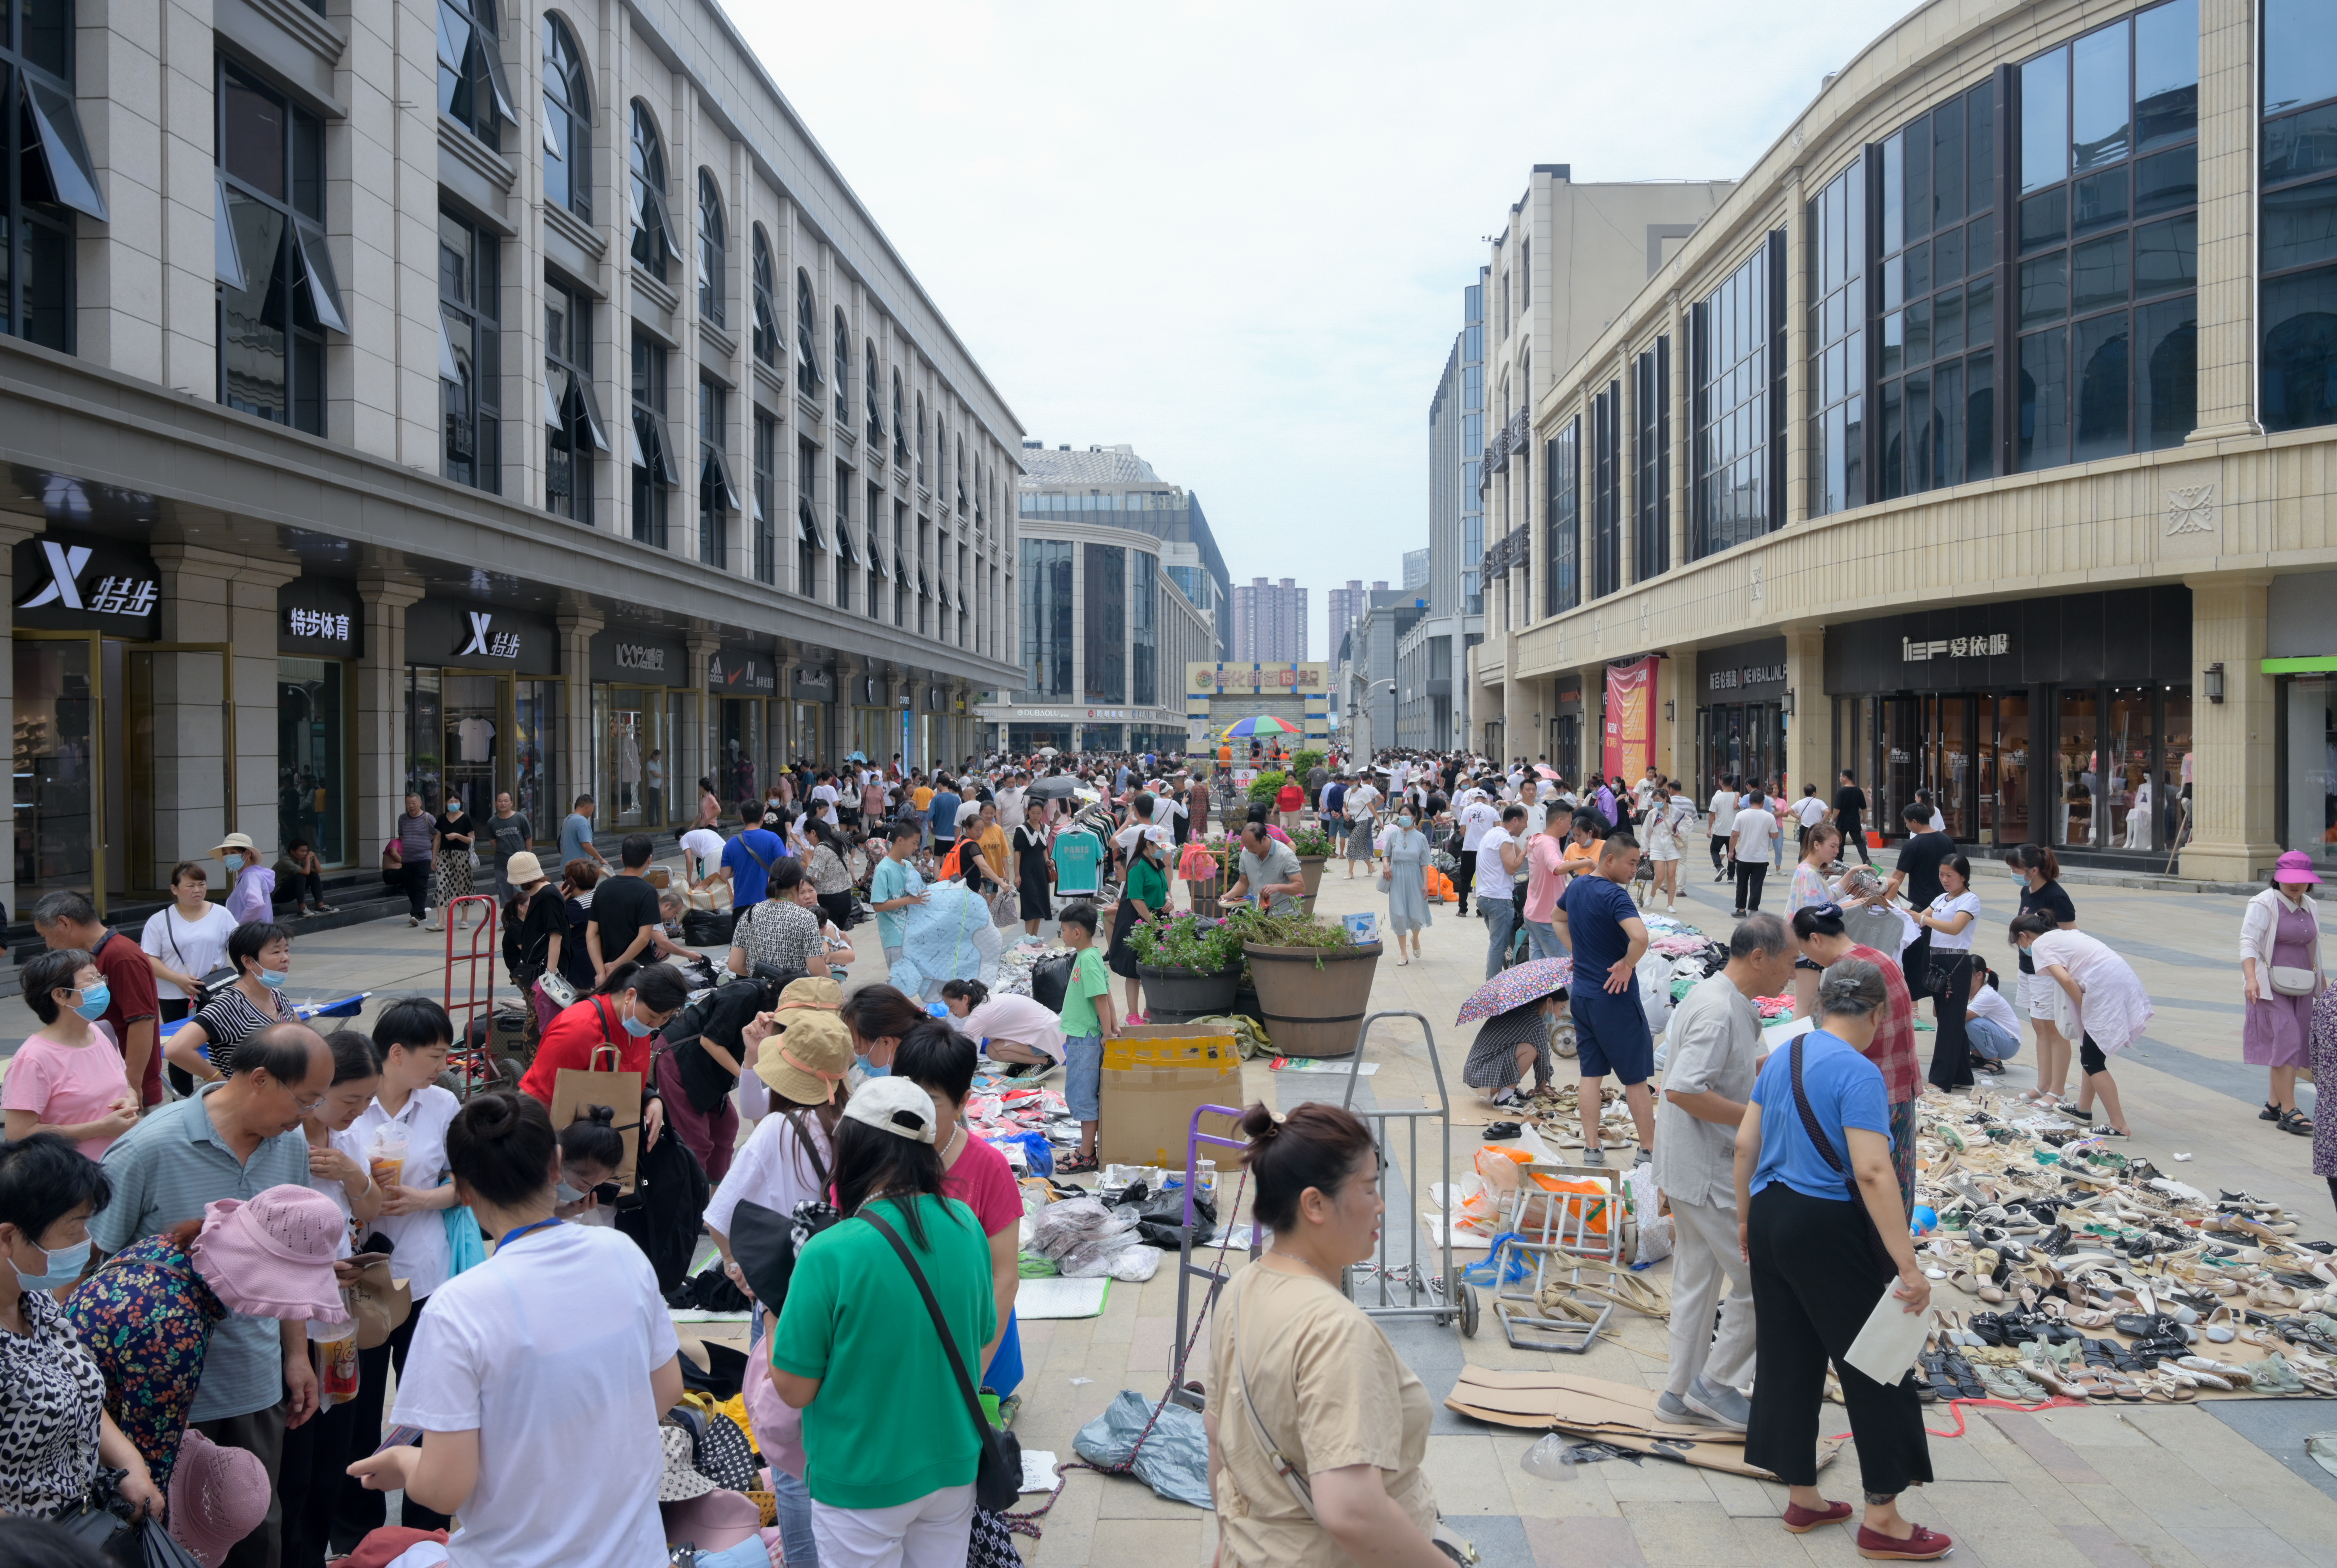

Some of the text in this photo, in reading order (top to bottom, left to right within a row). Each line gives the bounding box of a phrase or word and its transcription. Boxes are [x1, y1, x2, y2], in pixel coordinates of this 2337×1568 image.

[88, 576, 158, 616] 特步
[291, 607, 349, 640] 特步体育
[489, 632, 520, 658] 特步
[1950, 633, 2009, 658] 爱依服
[709, 673, 723, 683] adidas
[1710, 670, 1737, 690] 新百伦领跑
[1097, 710, 1123, 718] 同明眼镜
